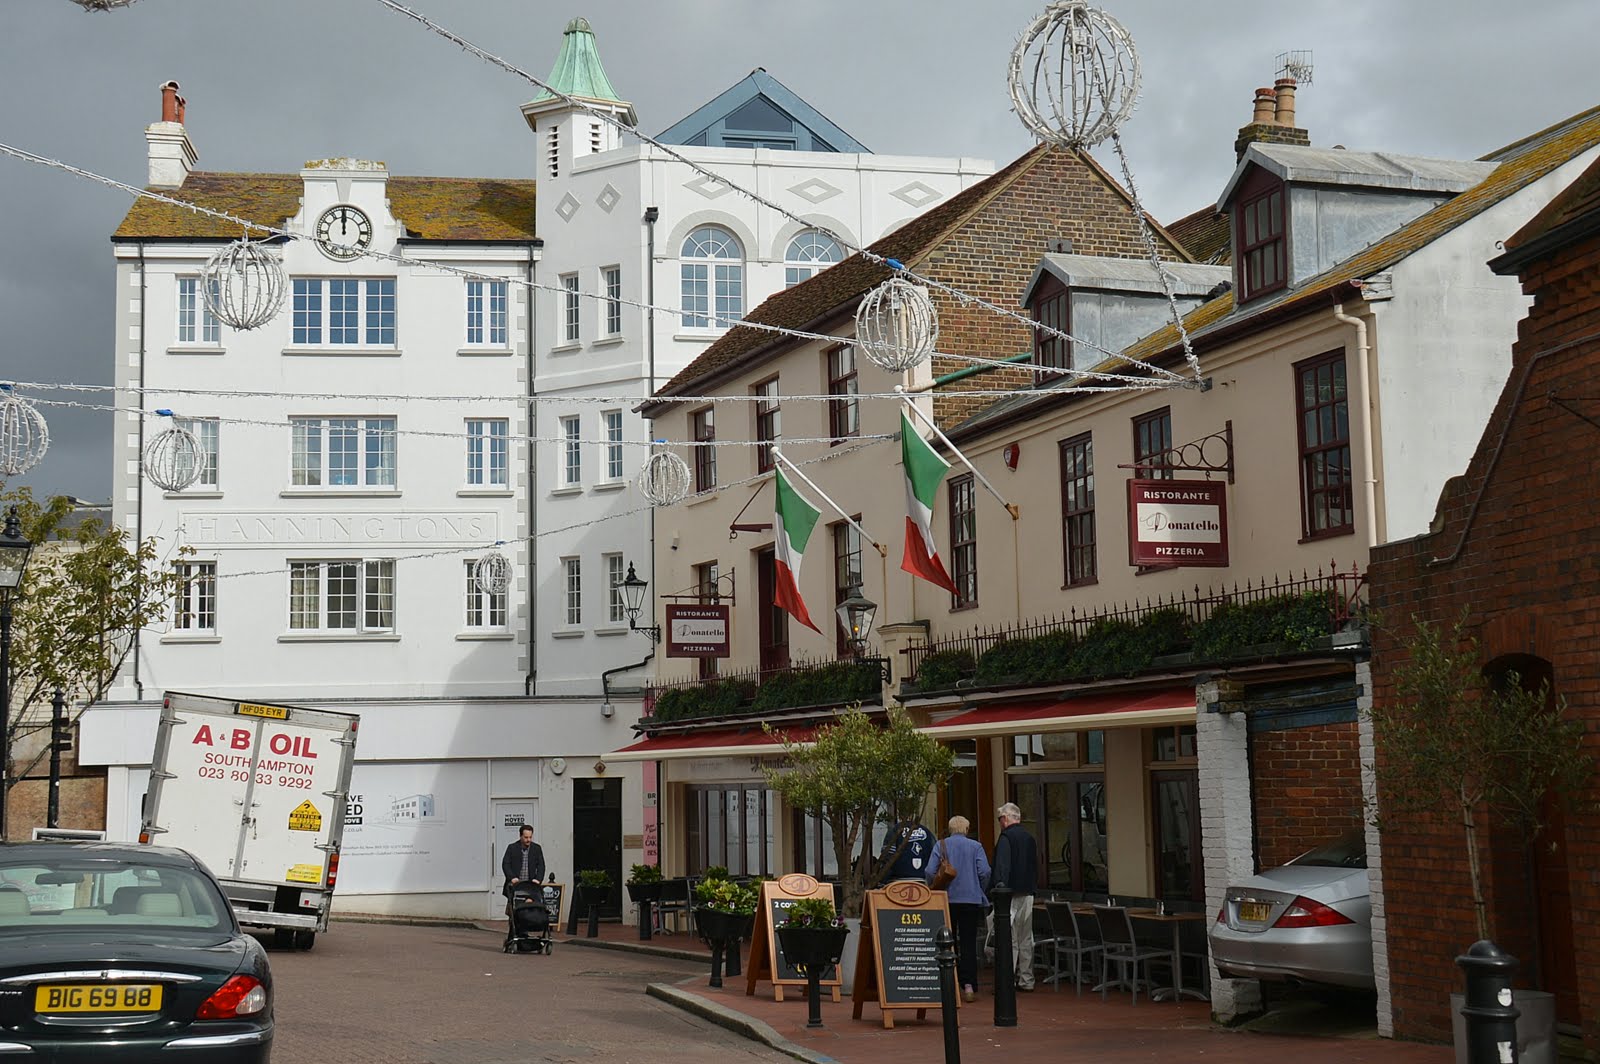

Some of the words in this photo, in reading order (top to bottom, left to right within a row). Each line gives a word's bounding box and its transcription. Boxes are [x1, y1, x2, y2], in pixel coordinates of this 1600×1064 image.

[1143, 491, 1211, 501] RISTORANTE
[196, 517, 483, 540] HANNINGTONS
[1140, 512, 1219, 532] Donatello
[1155, 547, 1205, 556] PIZZERIA
[677, 624, 725, 637] Donatello
[242, 704, 265, 715] HF05
[265, 708, 283, 717] EYR
[192, 724, 214, 747] A
[219, 733, 226, 741] &
[230, 728, 252, 750] B
[269, 733, 318, 759] OIL
[198, 766, 226, 780] 023
[230, 770, 250, 783] 80
[255, 773, 273, 786] 33
[278, 775, 313, 790] 9292
[901, 913, 922, 925] £3.95
[47, 989, 82, 1008] BIG
[89, 988, 117, 1007] 69
[123, 988, 151, 1007] 88
